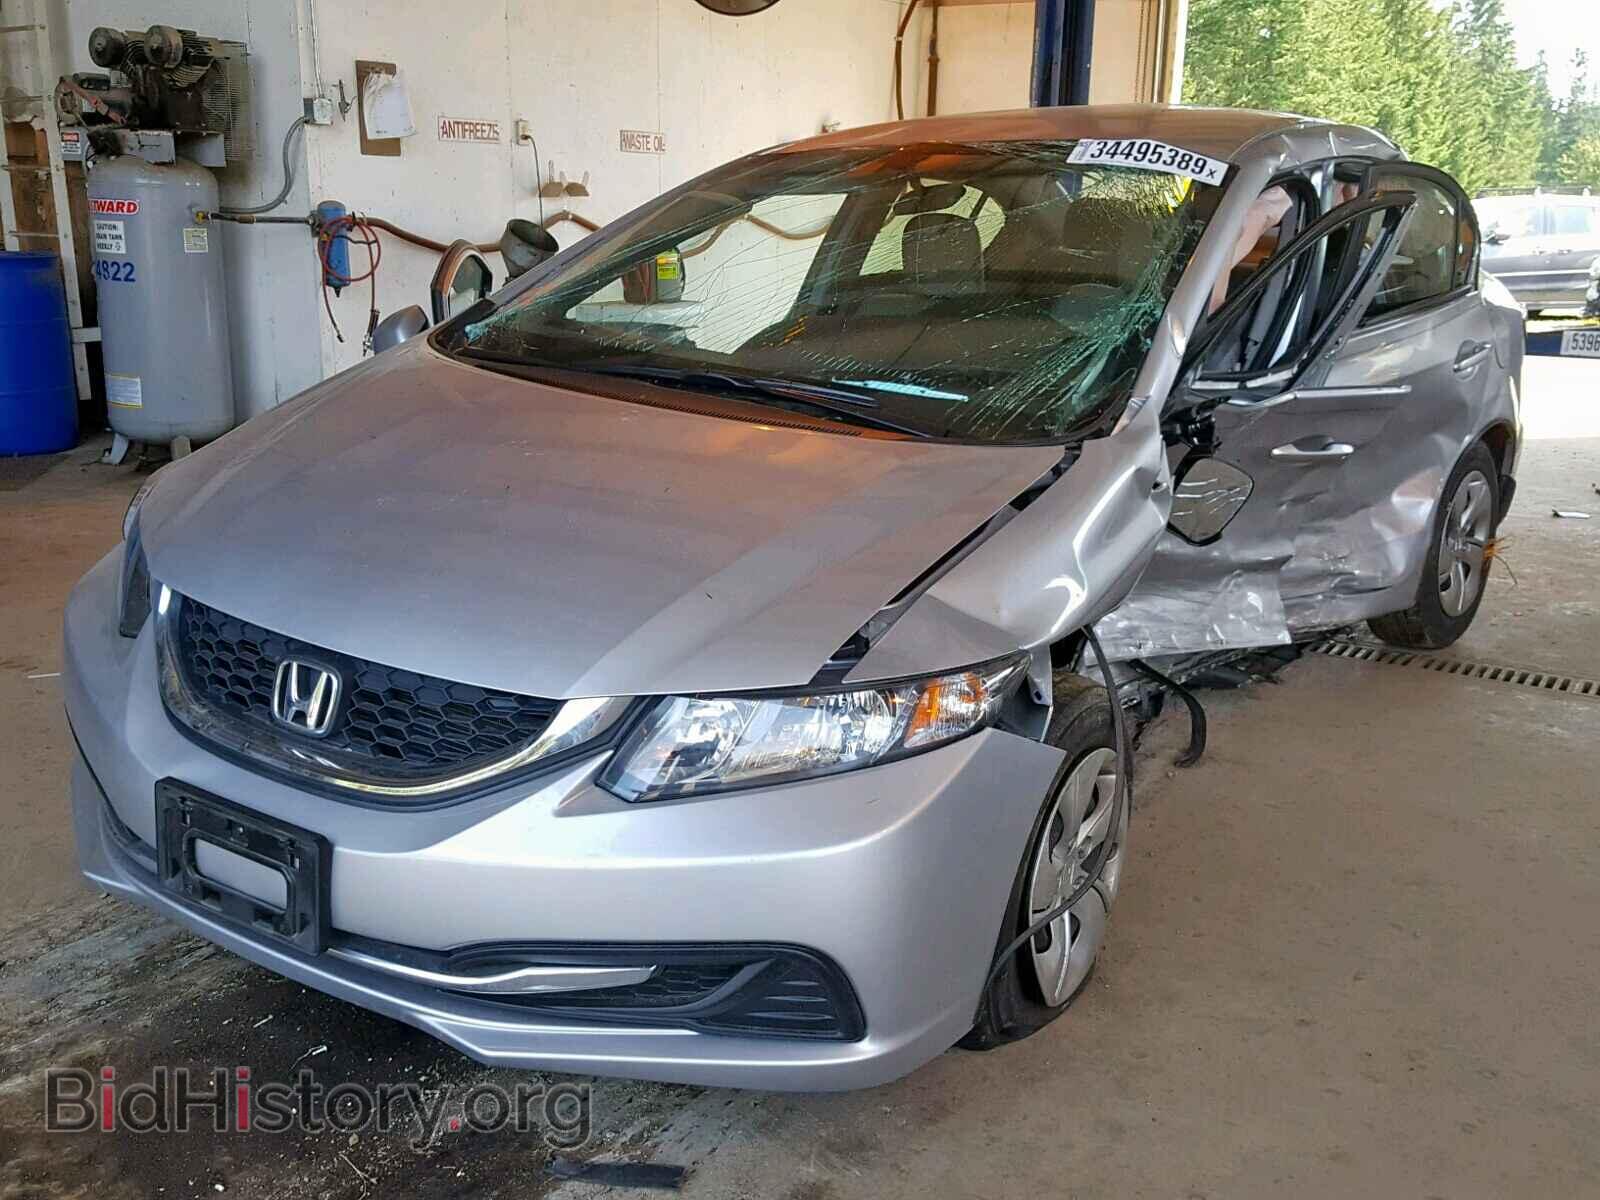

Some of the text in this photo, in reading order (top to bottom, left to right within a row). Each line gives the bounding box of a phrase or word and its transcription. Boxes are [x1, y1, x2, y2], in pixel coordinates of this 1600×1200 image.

[622, 133, 666, 152] WASTE OIL
[1090, 140, 1208, 176] 34495389
